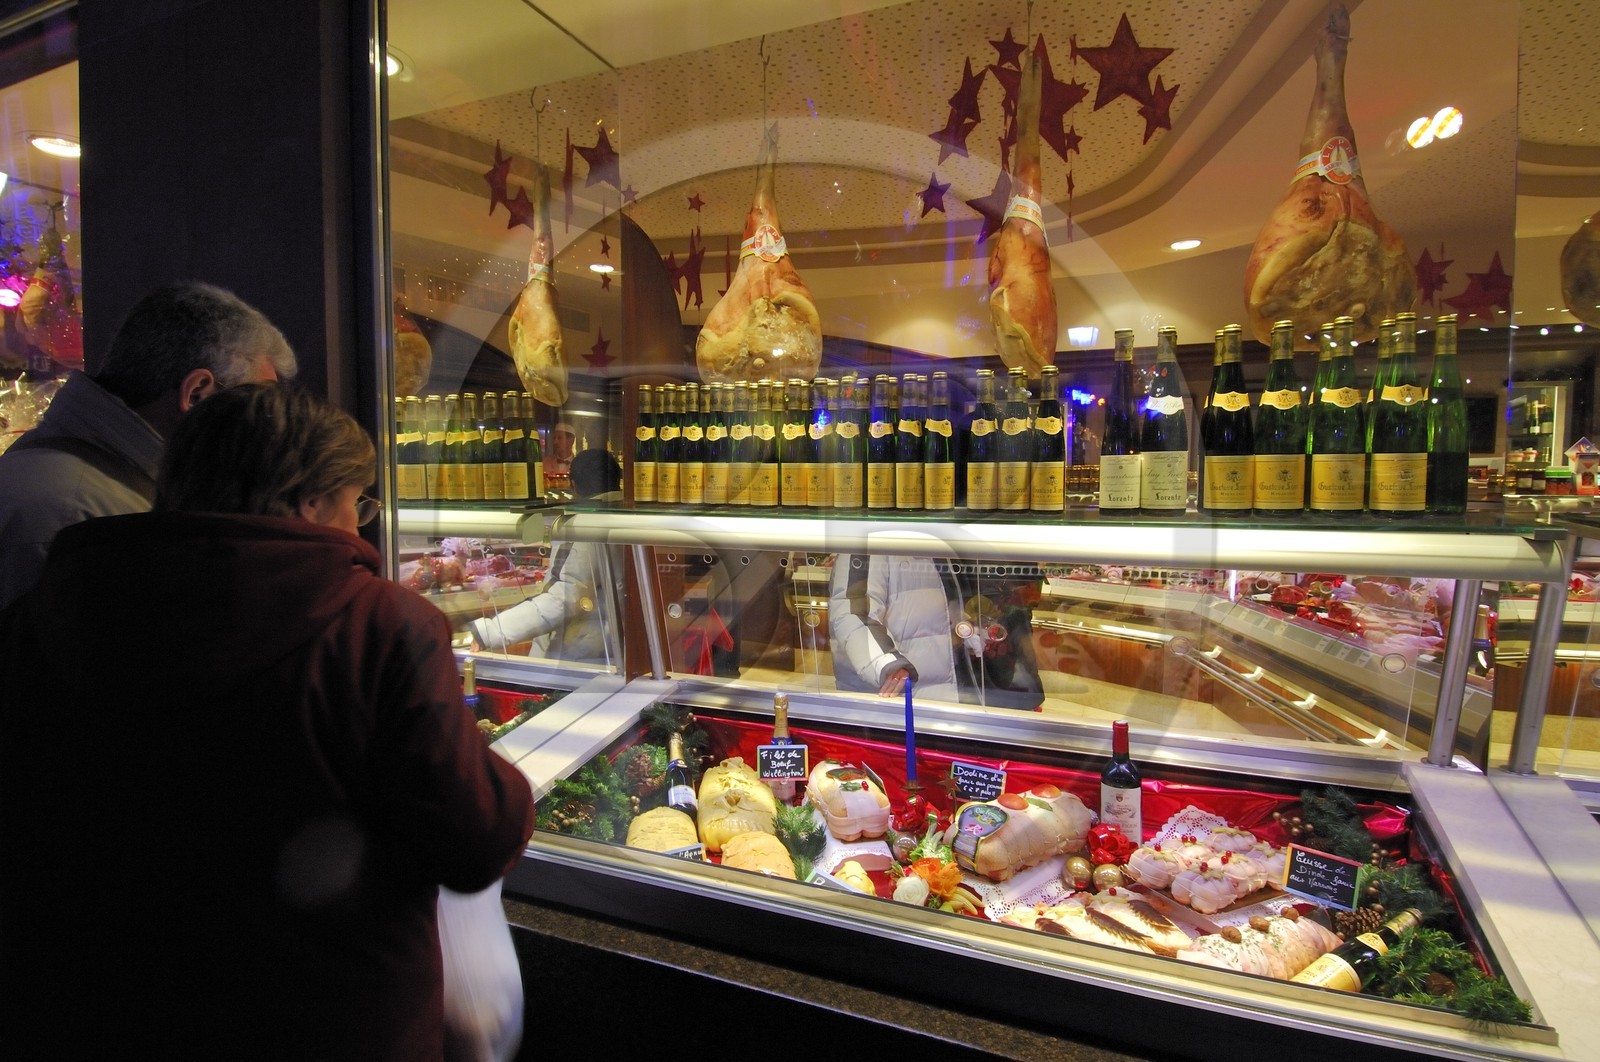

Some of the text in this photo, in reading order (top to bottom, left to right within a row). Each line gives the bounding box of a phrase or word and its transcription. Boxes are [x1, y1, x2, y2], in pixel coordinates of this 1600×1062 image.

[1108, 493, 1134, 502] Lorentz
[1155, 491, 1181, 501] Lorentz
[760, 750, 801, 760] Filet de
[953, 766, 989, 780] Dodine
